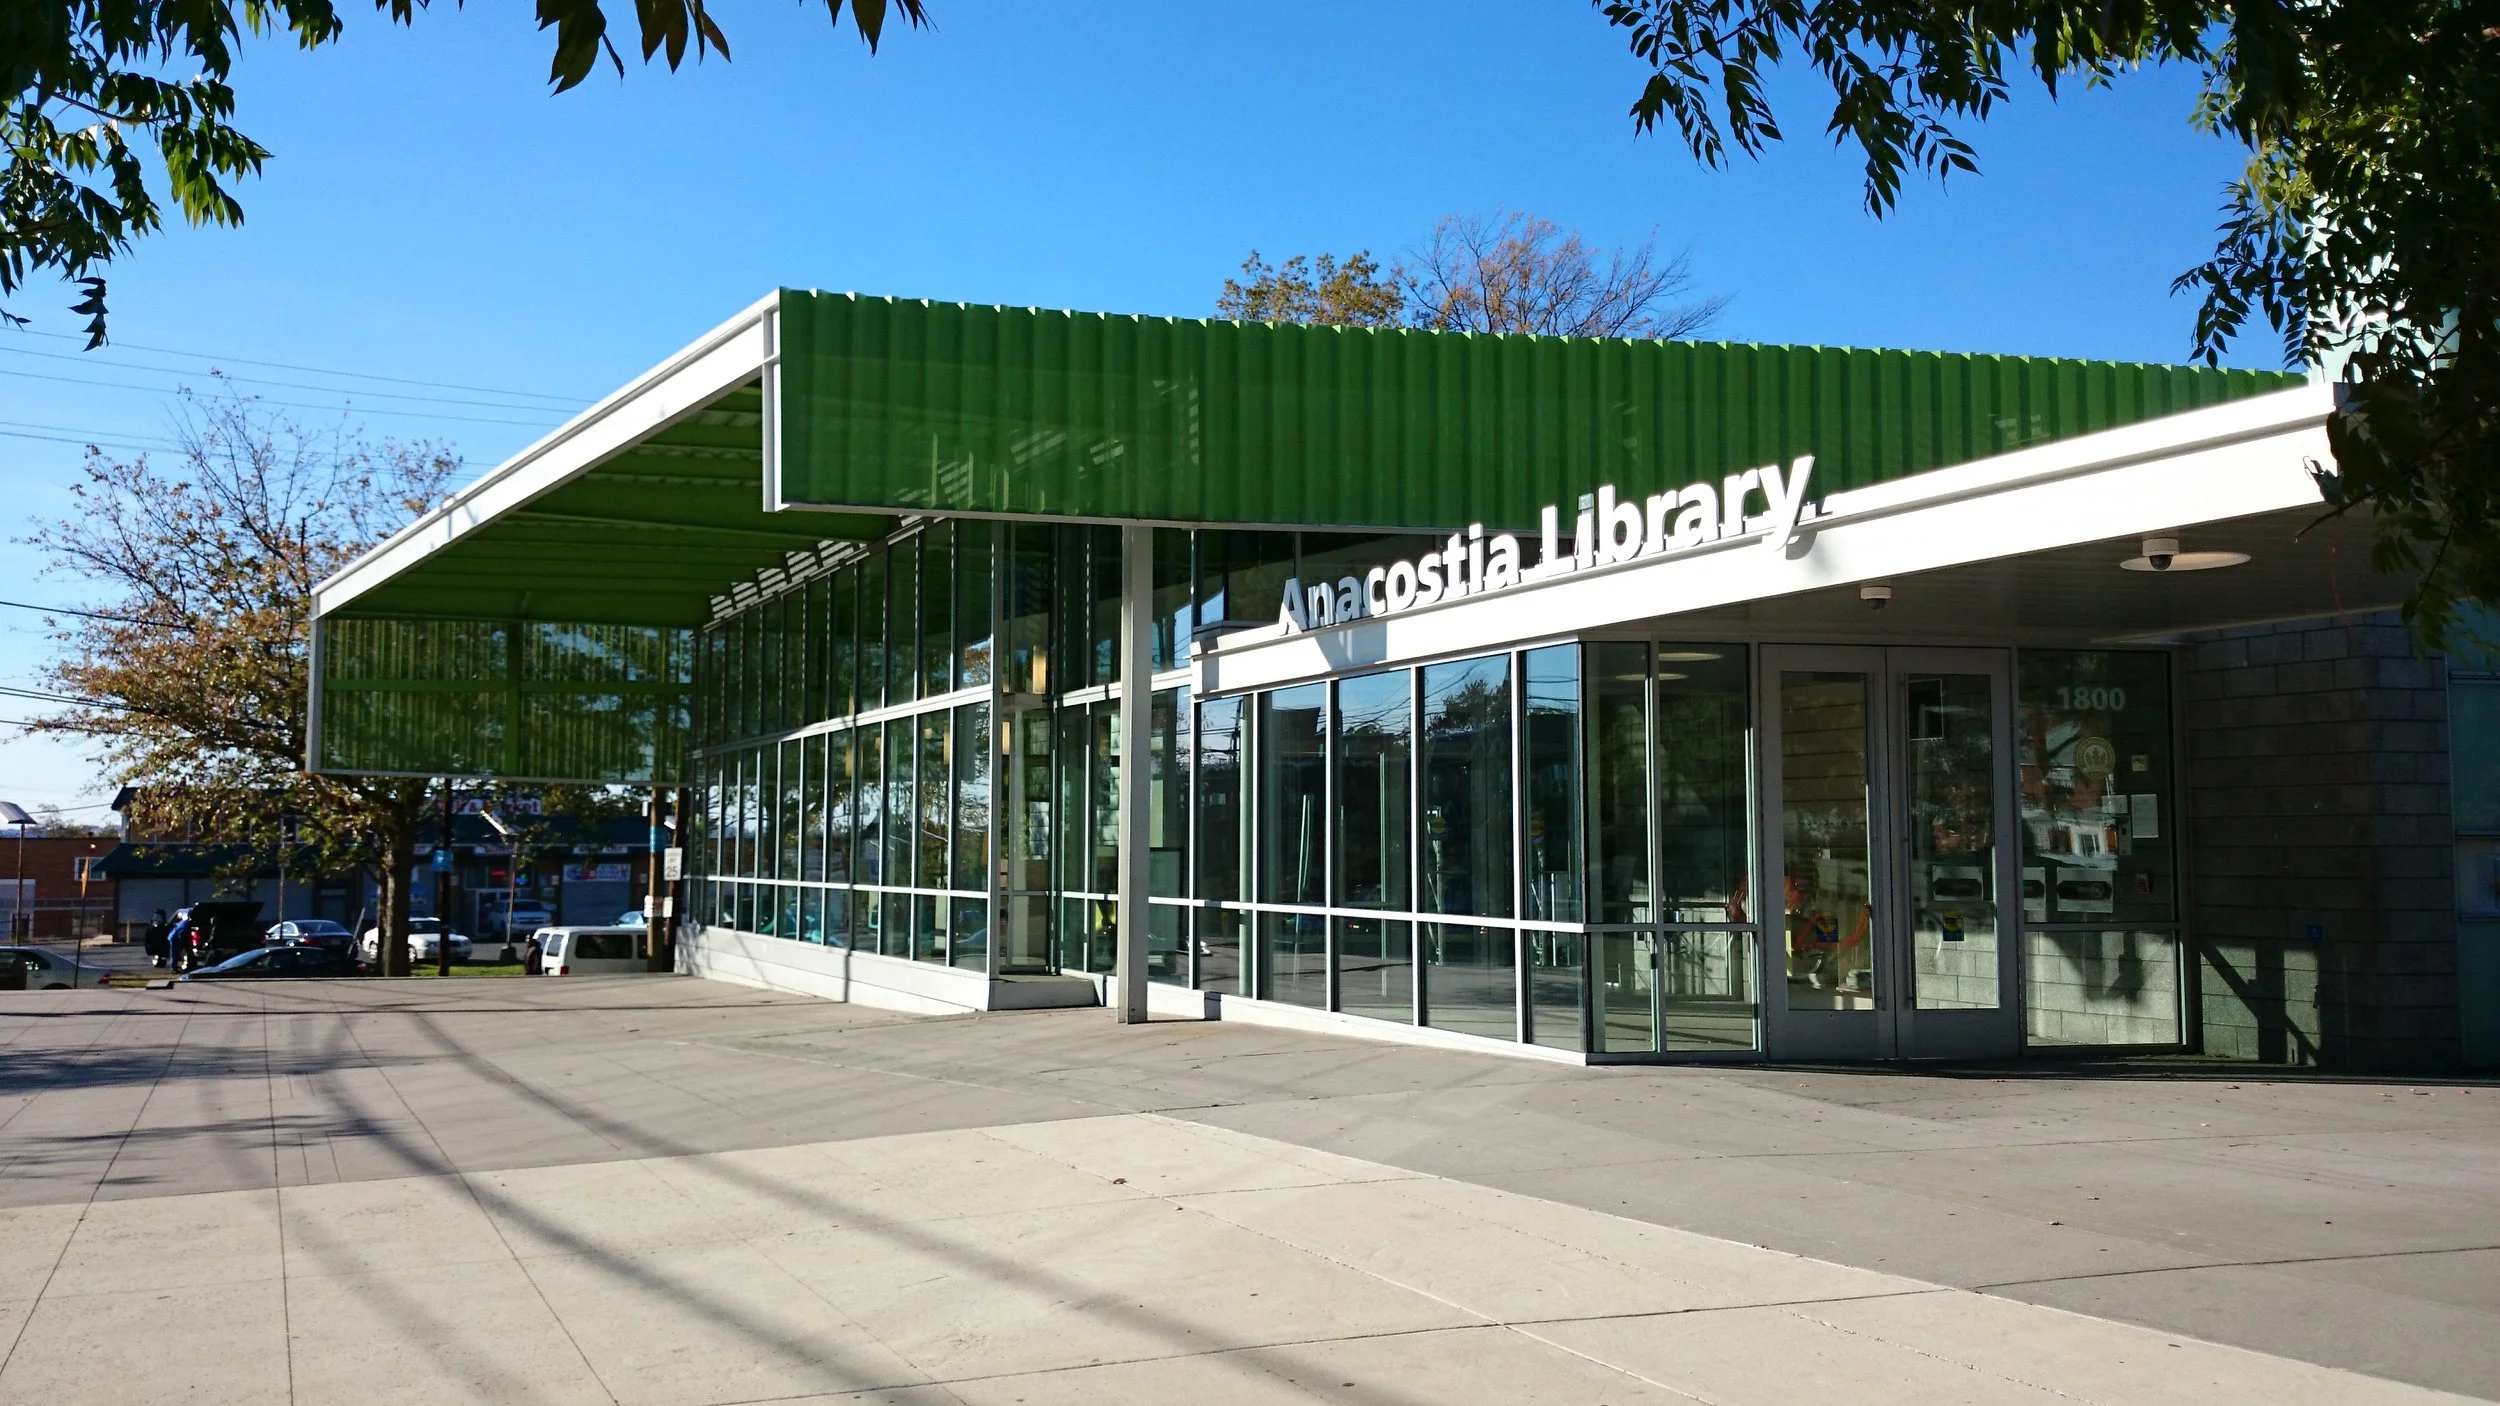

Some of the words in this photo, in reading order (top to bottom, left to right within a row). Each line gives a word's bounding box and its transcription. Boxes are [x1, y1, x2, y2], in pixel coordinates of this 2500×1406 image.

[1279, 522, 1521, 634] Anacostia
[1540, 455, 1816, 577] Library
[2056, 686, 2126, 711] 1800
[666, 866, 679, 878] 25
